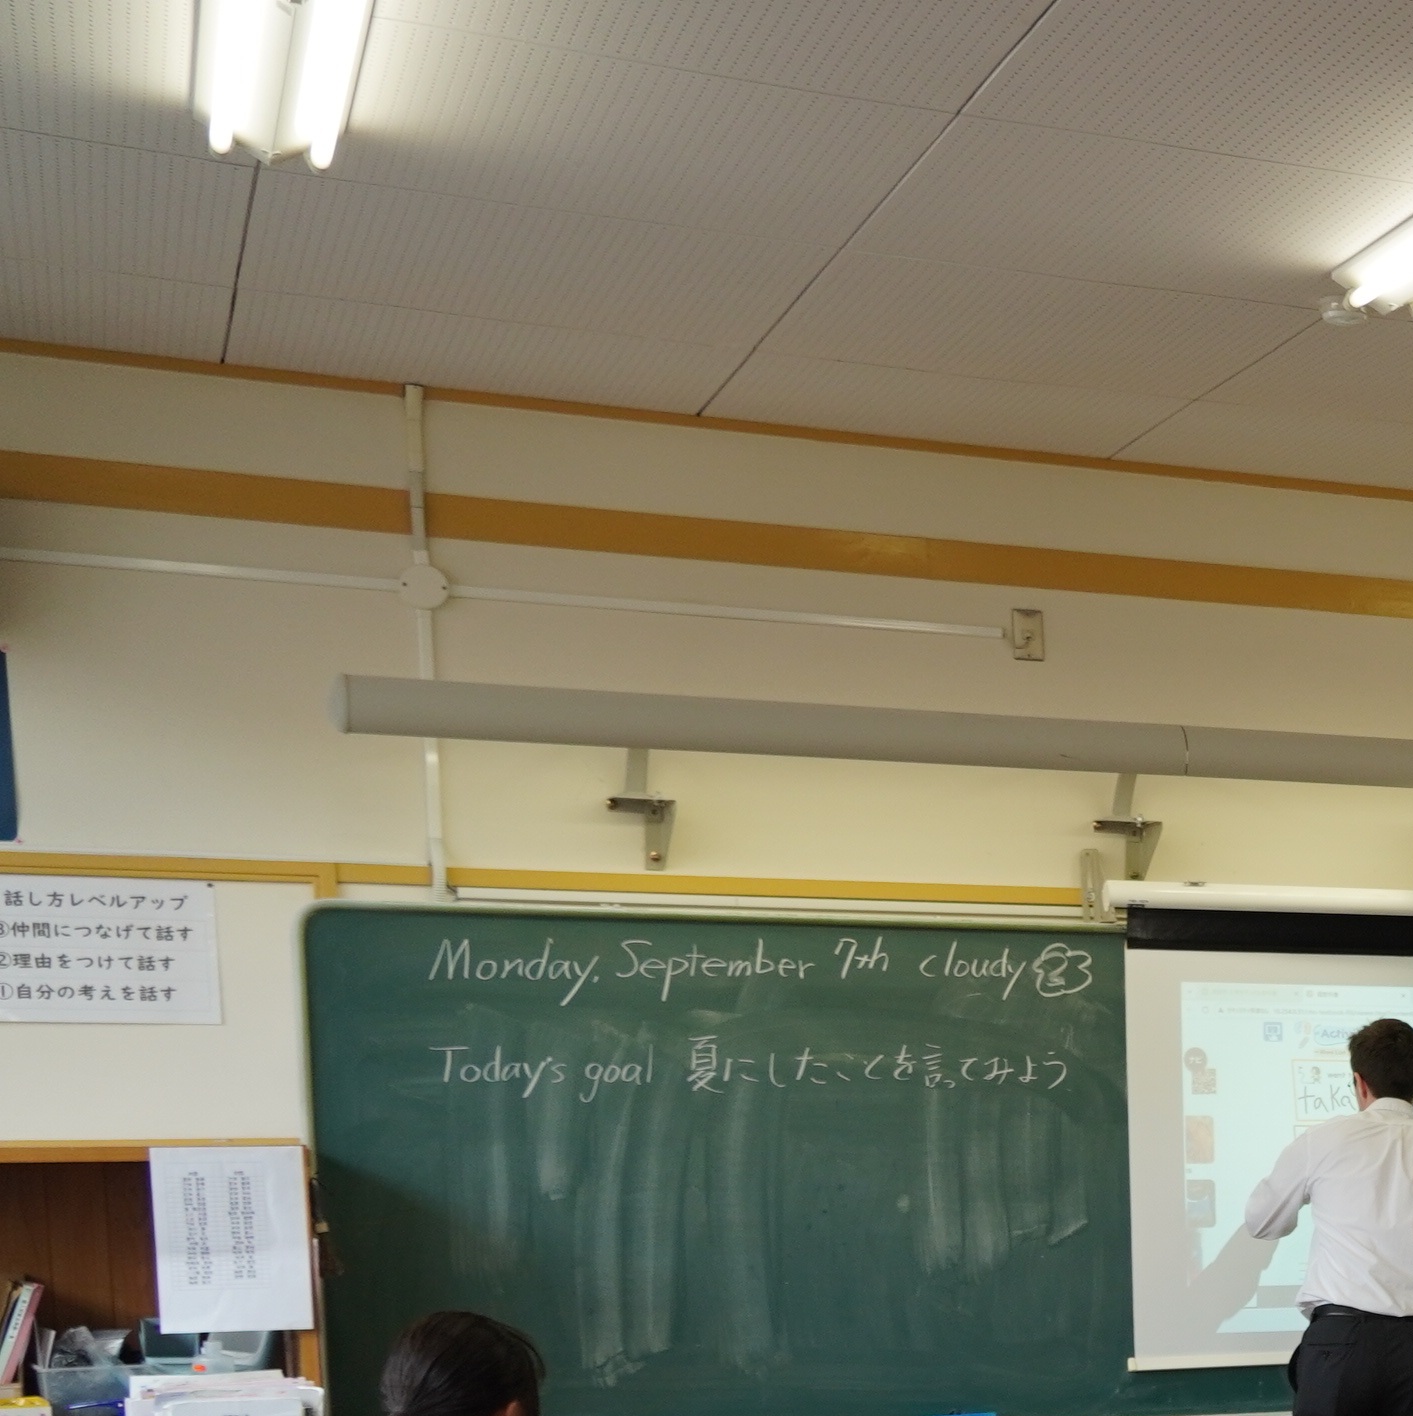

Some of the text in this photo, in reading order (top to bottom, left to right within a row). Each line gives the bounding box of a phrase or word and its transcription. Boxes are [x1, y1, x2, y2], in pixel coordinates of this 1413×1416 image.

[3, 889, 189, 911] 話し方レベルアップ
[0, 982, 178, 1002] ①自分の考えを話す
[615, 938, 816, 1002] September
[834, 935, 889, 980] 7th
[919, 938, 1027, 1001] cloudy
[428, 1042, 655, 1103] Today's goal
[686, 1034, 1068, 1094] 夏にしたことを言ってみよう
